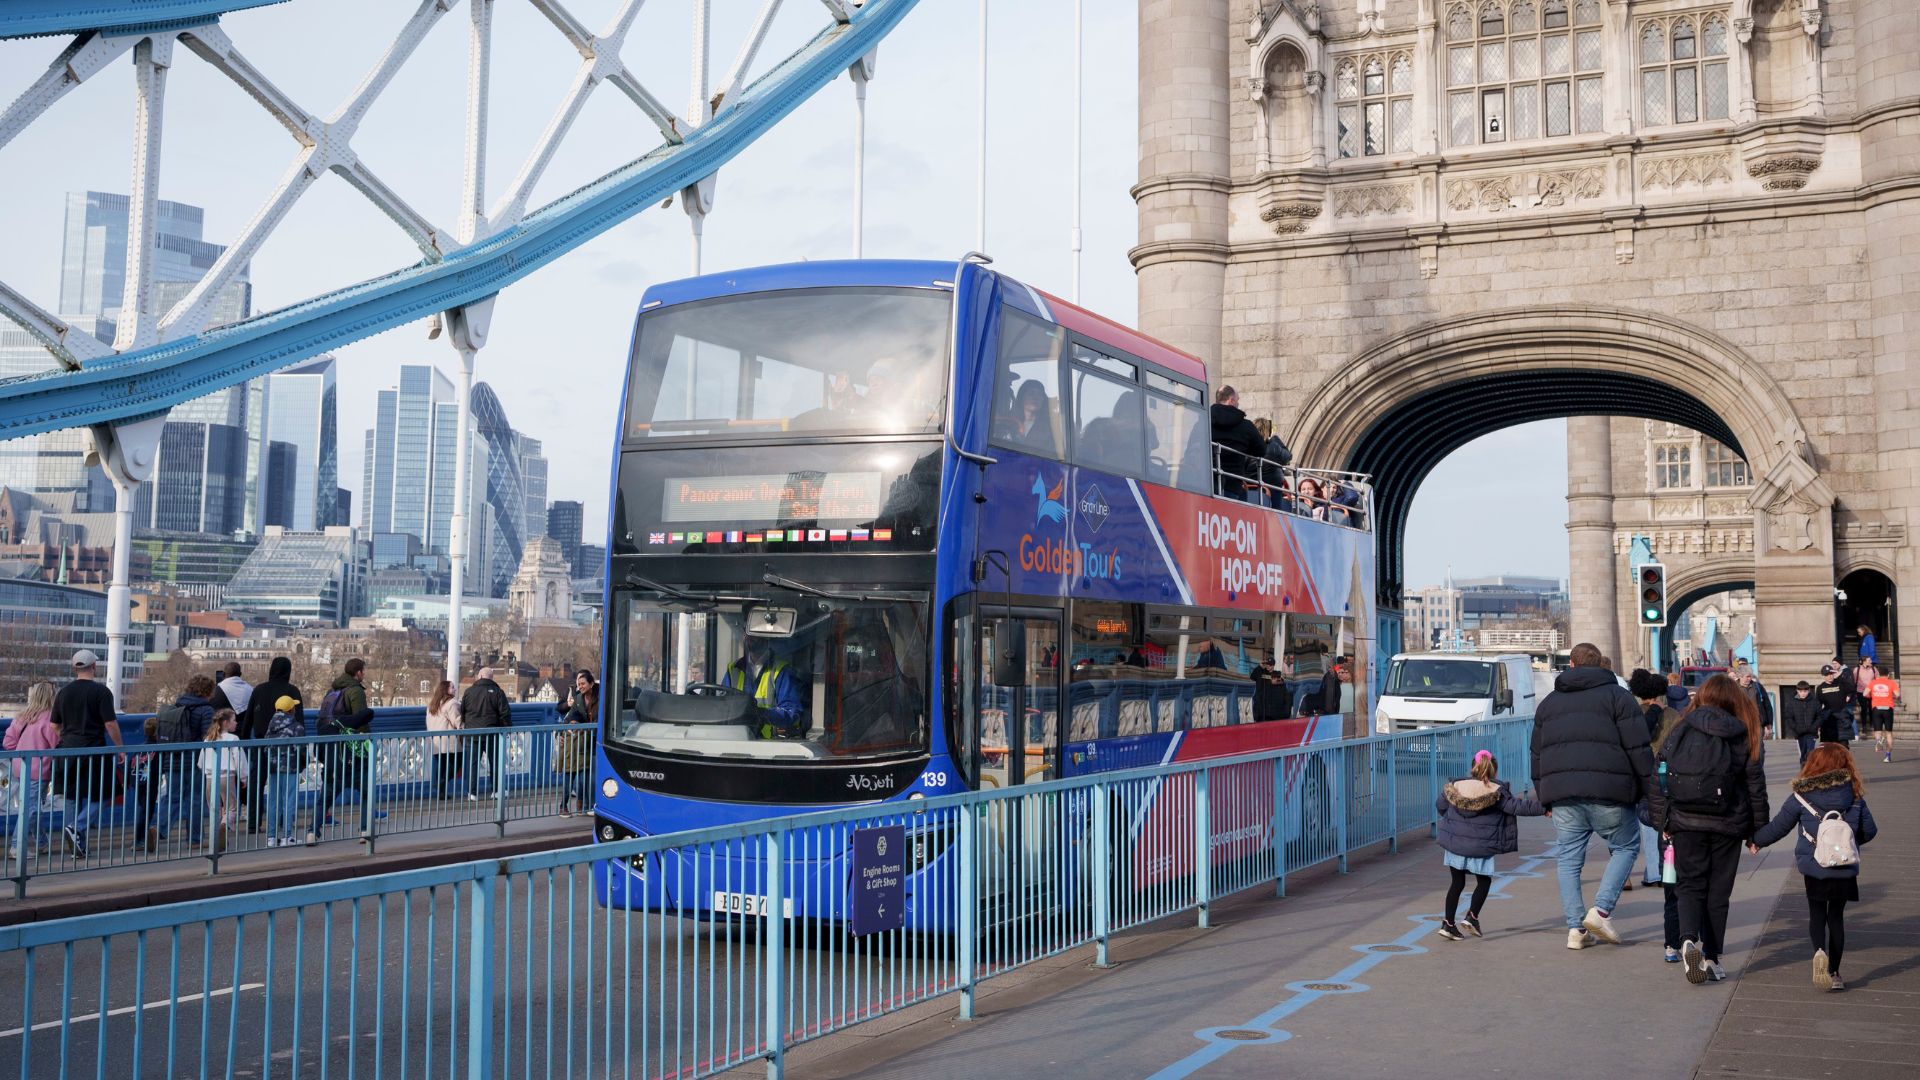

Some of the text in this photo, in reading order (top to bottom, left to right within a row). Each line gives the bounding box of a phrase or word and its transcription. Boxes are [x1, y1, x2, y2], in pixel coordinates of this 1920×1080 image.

[1198, 510, 1257, 556] HOP-ON
[1221, 556, 1283, 597] HOP-OFF
[628, 770, 665, 781] VOLVO
[921, 771, 947, 787] 139
[863, 864, 900, 878] Engine Rooms
[866, 877, 897, 890] & Gift Shop
